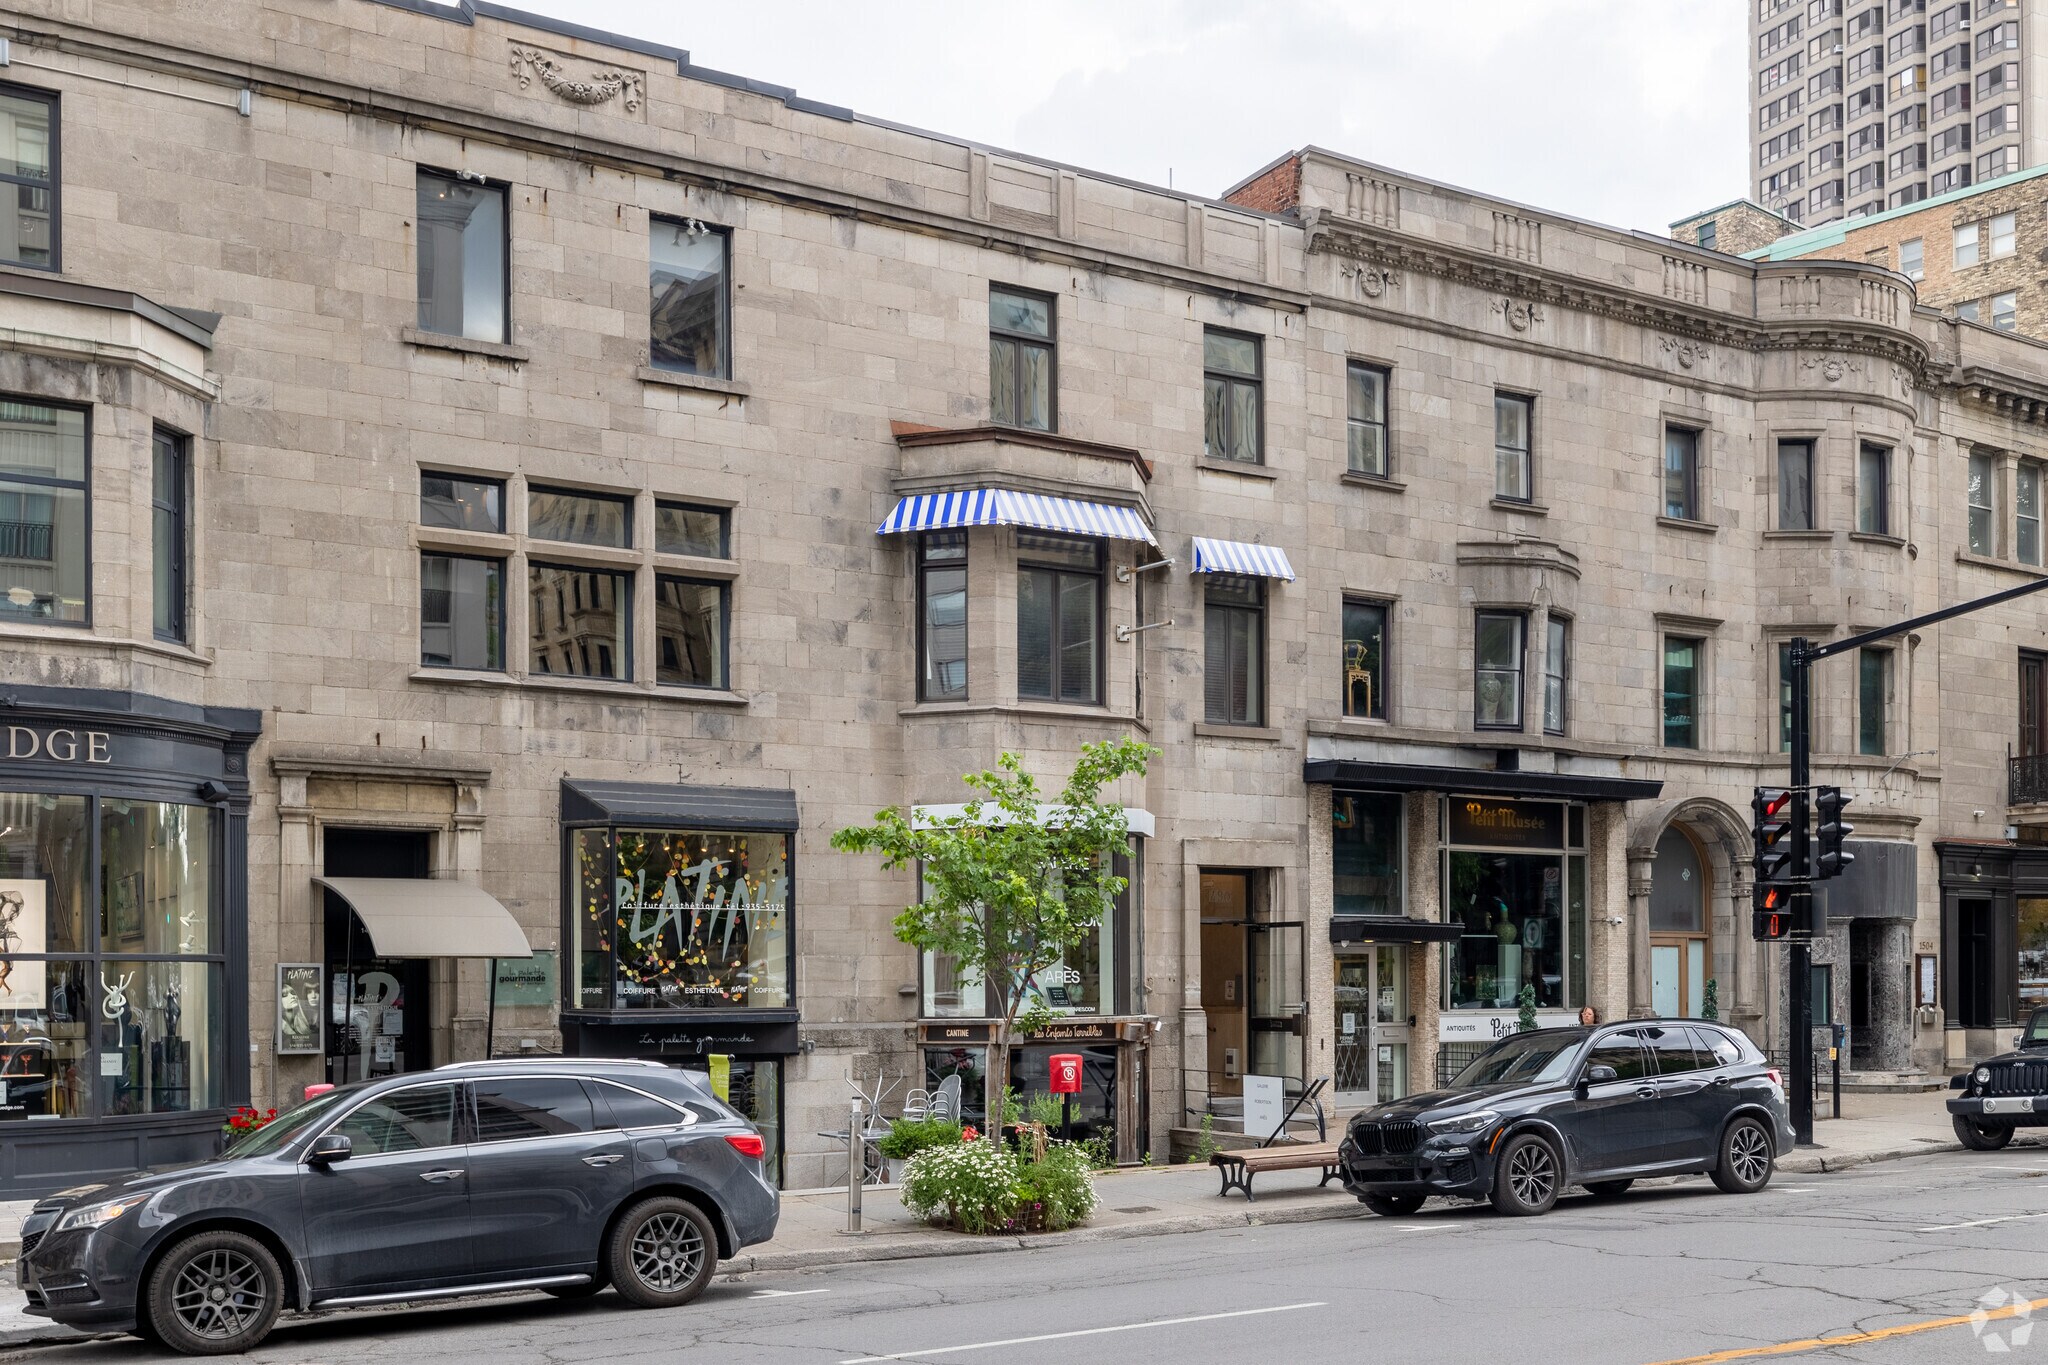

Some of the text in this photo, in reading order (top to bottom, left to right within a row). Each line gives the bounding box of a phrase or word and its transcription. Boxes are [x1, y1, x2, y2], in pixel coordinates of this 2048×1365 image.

[6, 726, 112, 763] DGE
[1467, 802, 1546, 829] Petit Musée
[622, 901, 664, 909] Coiffure
[1919, 942, 1934, 951] 1504
[499, 975, 546, 984] gourmande
[1045, 966, 1080, 984] ARÈS
[623, 987, 656, 995] COIFFURE
[946, 1029, 969, 1037] CANTINE
[1046, 1026, 1073, 1040] Enfants
[1073, 1025, 1102, 1038] Terribles
[639, 1033, 655, 1044] La
[658, 1034, 693, 1052] palette
